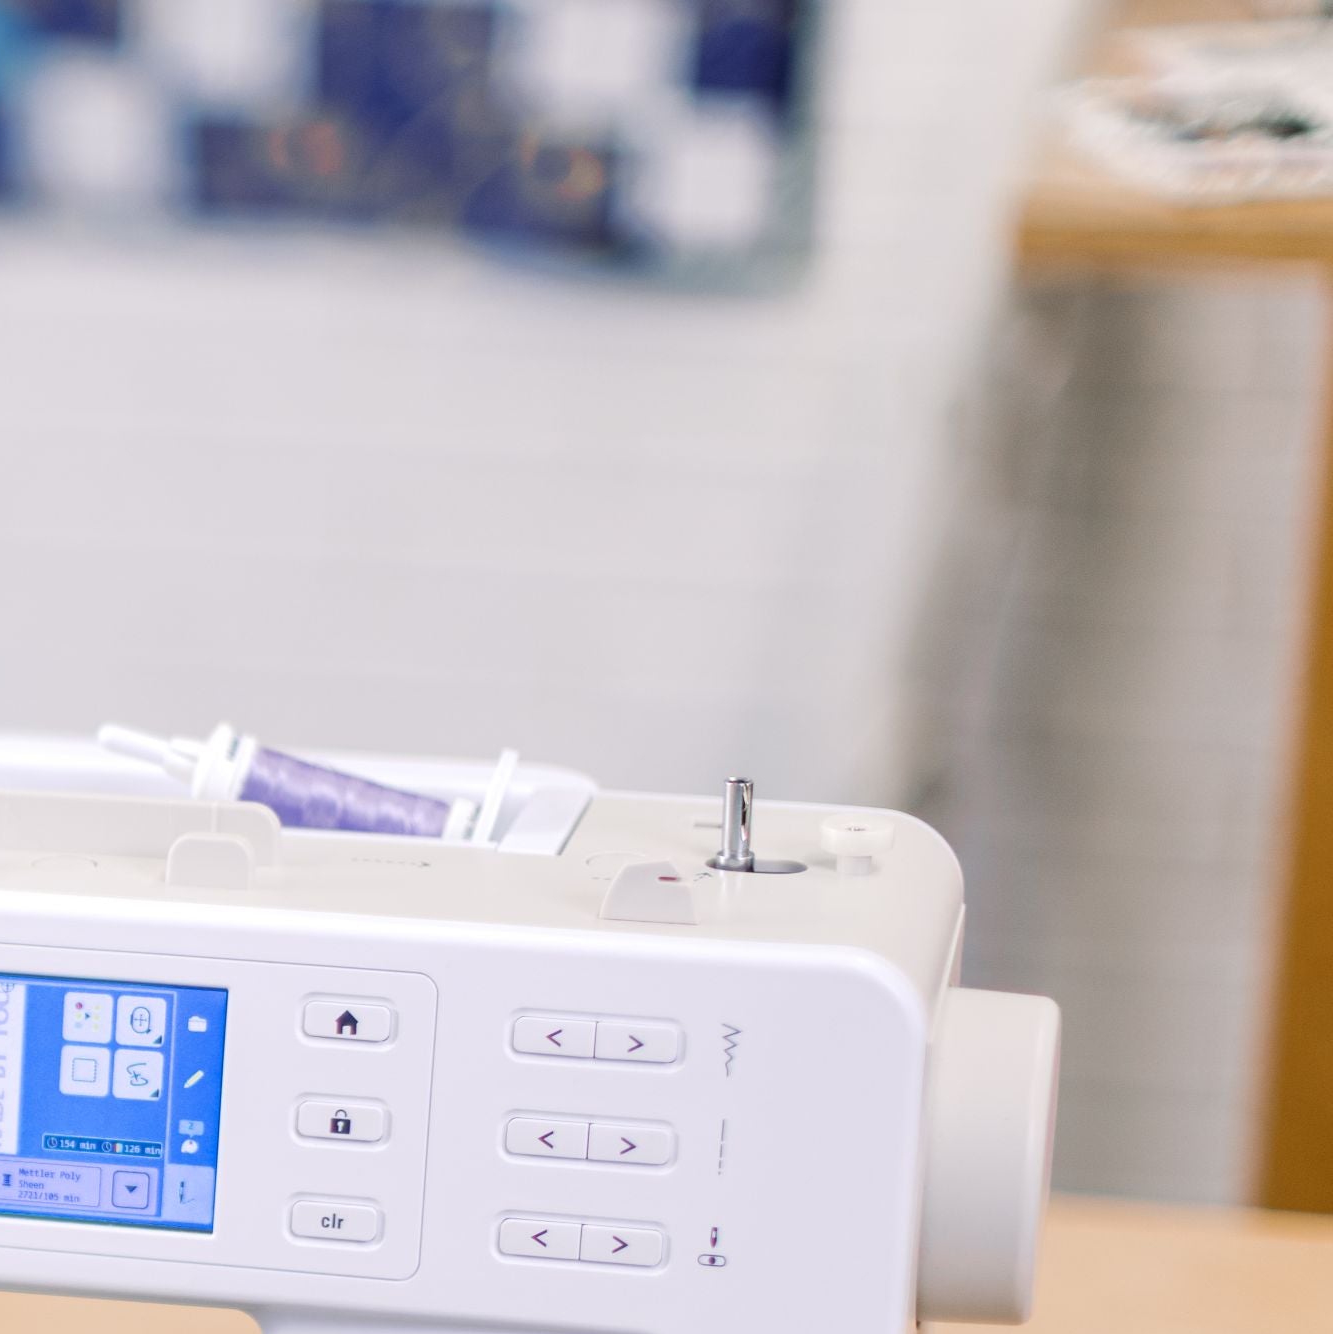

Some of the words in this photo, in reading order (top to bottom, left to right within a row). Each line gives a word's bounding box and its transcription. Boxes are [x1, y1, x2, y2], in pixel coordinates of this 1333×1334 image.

[59, 1138, 76, 1149] 154
[79, 1140, 97, 1150] min
[124, 1144, 141, 1154] 126
[144, 1145, 161, 1155] min
[18, 1168, 55, 1179] Mettler
[60, 1170, 81, 1182] Poly
[18, 1179, 45, 1190] Sheen
[63, 1194, 80, 1203] min
[320, 1212, 345, 1230] clr
